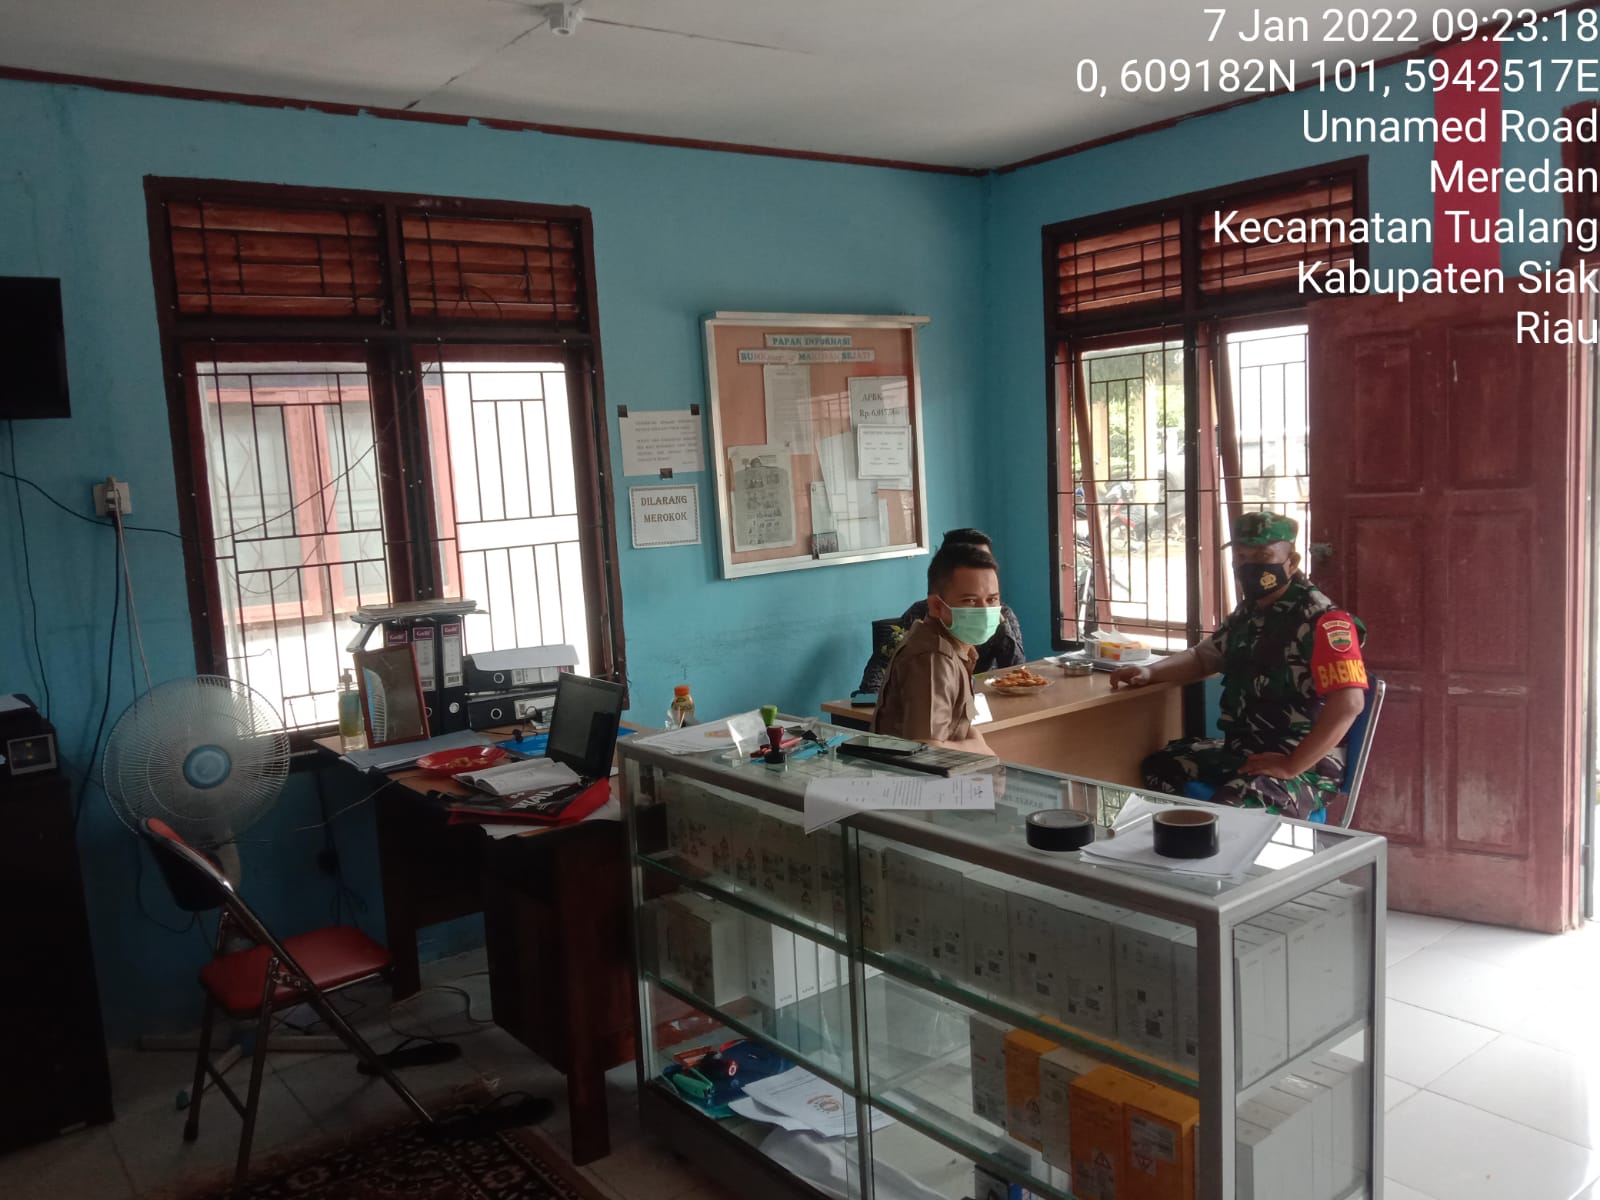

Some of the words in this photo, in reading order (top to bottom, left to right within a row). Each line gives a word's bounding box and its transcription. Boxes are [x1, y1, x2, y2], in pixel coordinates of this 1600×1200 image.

[640, 496, 688, 507] DILARANG
[643, 512, 688, 523] MEROKOK
[1318, 660, 1367, 688] BABINS
